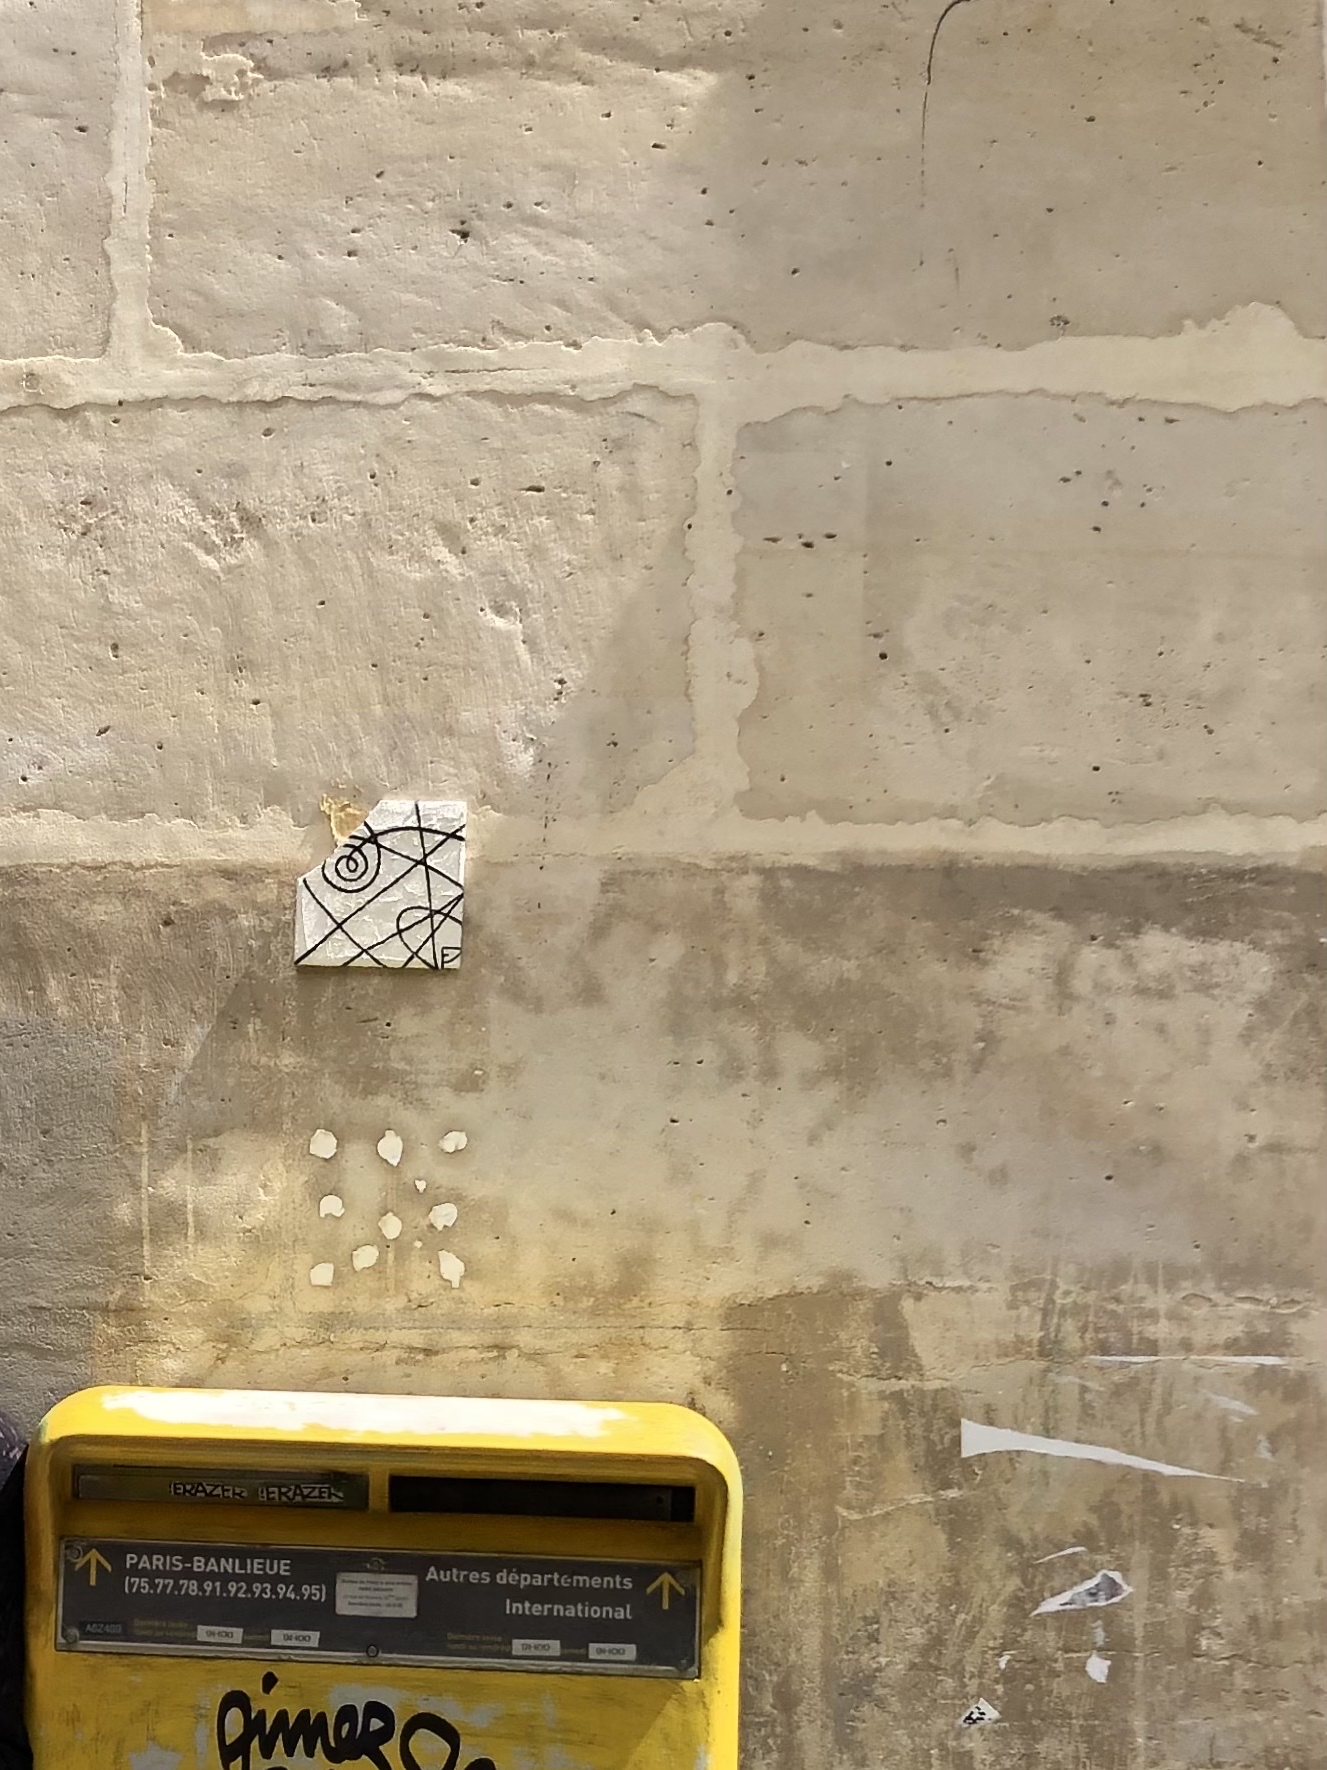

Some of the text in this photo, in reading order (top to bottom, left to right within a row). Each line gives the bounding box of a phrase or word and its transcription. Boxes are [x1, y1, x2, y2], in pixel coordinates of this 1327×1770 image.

[125, 1553, 292, 1576] PARIS-BANLIEUE
[124, 1576, 327, 1602] (75.77.78.91.92.93.94.95)
[425, 1566, 633, 1590] Autres départements
[505, 1598, 633, 1620] International
